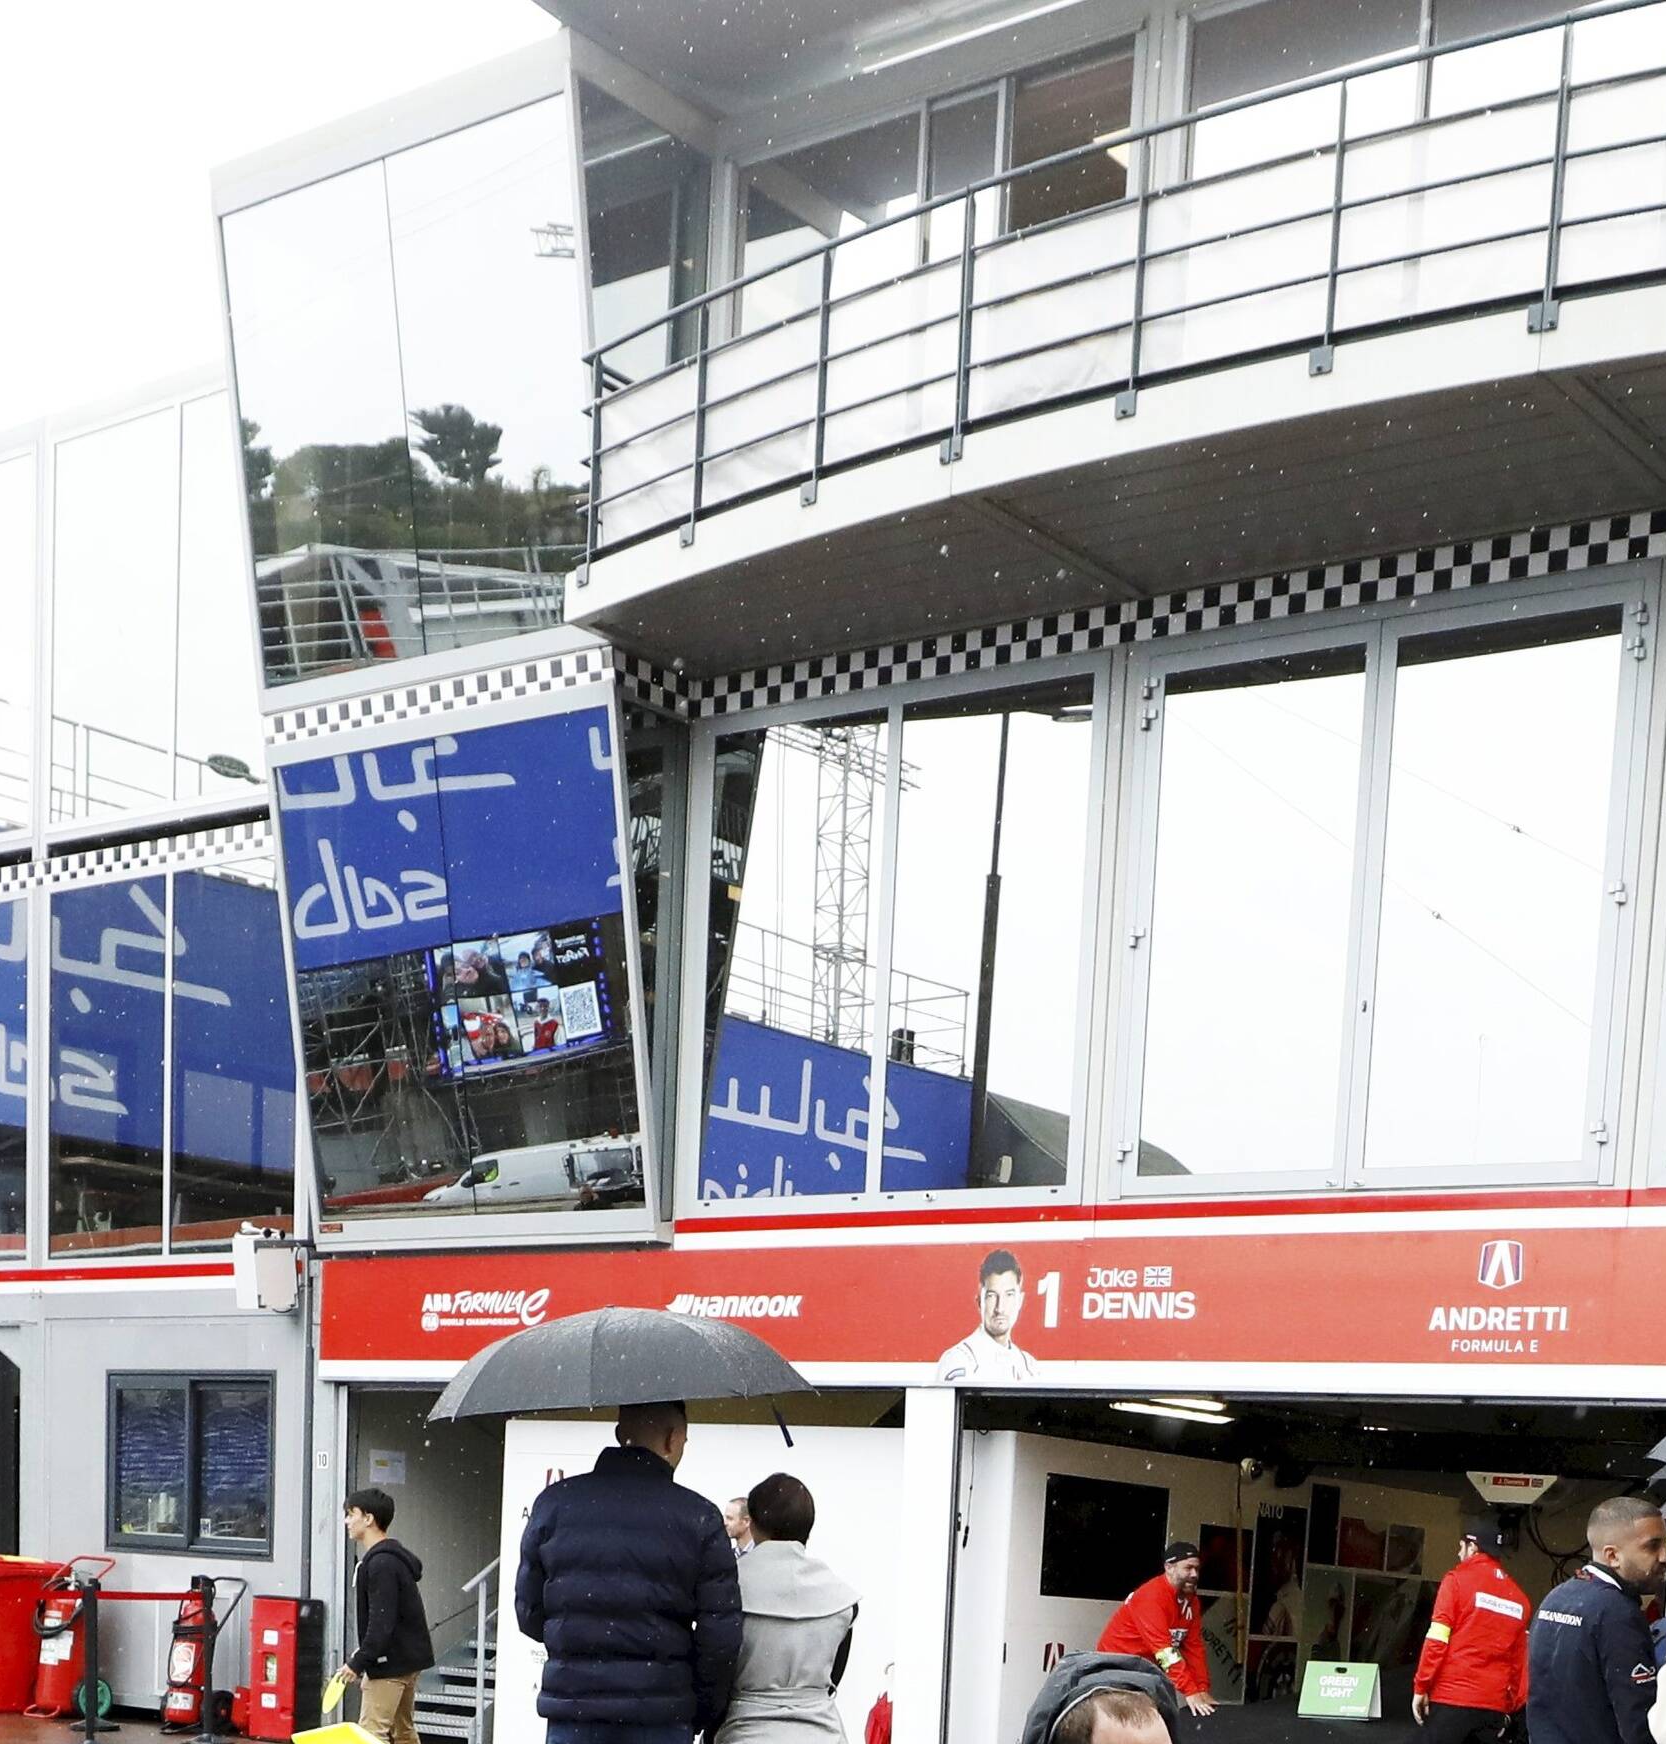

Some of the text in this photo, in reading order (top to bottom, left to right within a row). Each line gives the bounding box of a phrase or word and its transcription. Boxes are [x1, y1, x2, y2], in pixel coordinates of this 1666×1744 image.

[1086, 1267, 1138, 1289] Jake
[421, 1293, 451, 1313] ABB
[1036, 1271, 1061, 1329] 1
[1082, 1291, 1197, 1320] DENNIS
[1429, 1306, 1569, 1332] ANDRETTI
[1451, 1339, 1539, 1353] FORMULA E
[1318, 1675, 1359, 1688] GREEN
[1320, 1687, 1355, 1699] LIGHT
